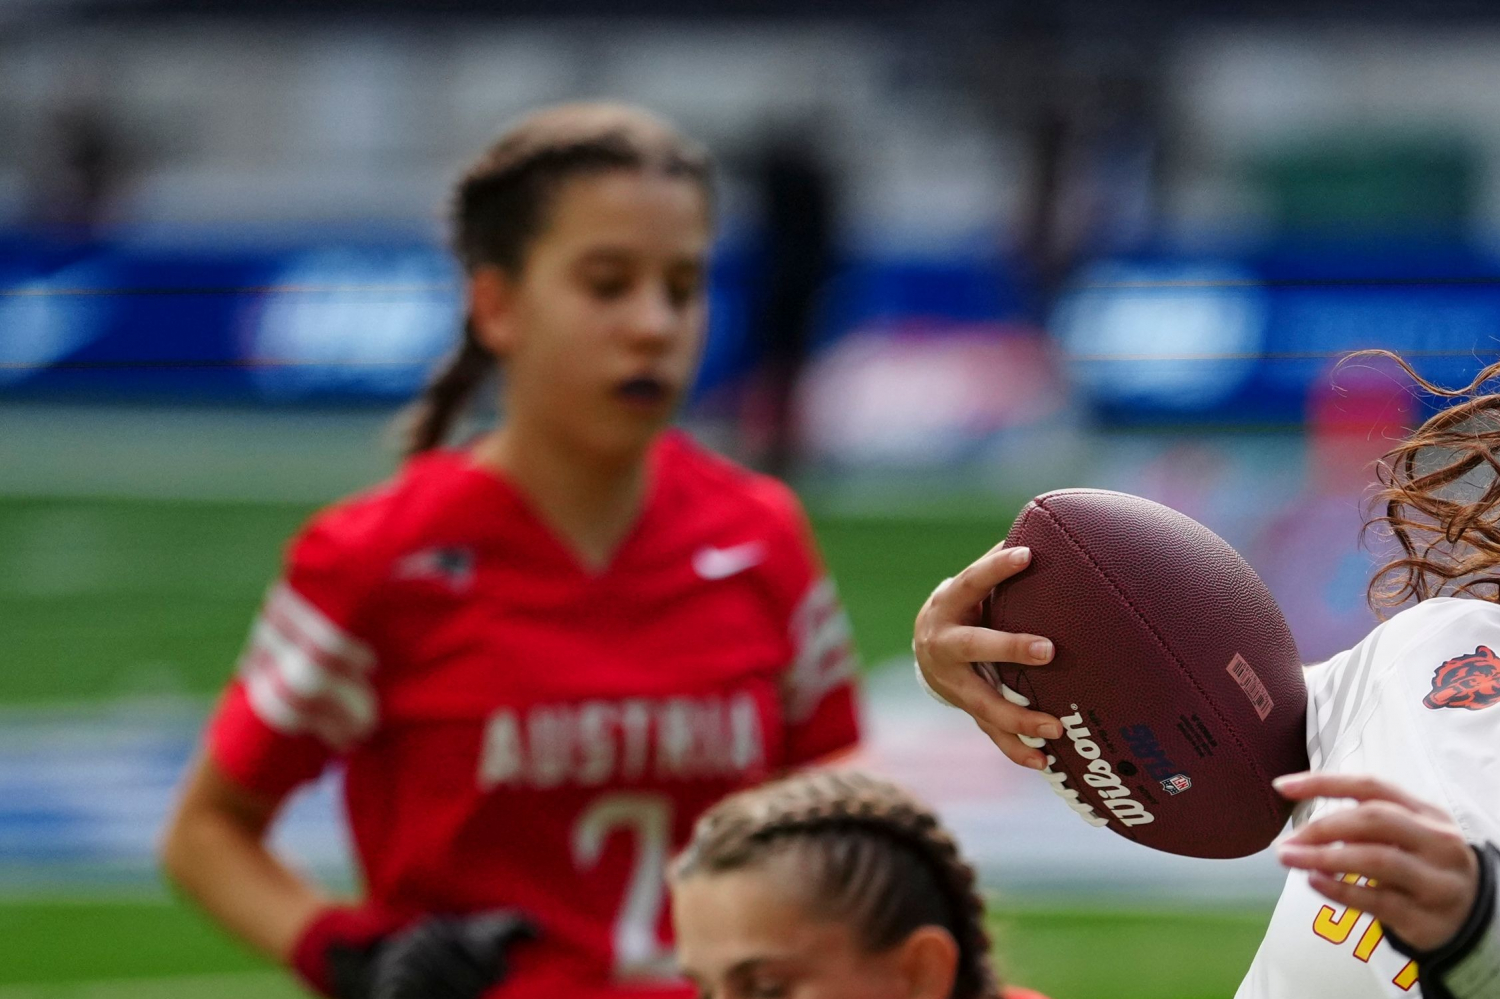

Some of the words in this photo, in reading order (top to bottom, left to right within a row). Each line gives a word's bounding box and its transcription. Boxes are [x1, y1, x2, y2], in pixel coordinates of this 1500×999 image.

[476, 693, 766, 791] AUSTRIA
[1060, 712, 1155, 827] Wilson
[569, 793, 684, 985] 2
